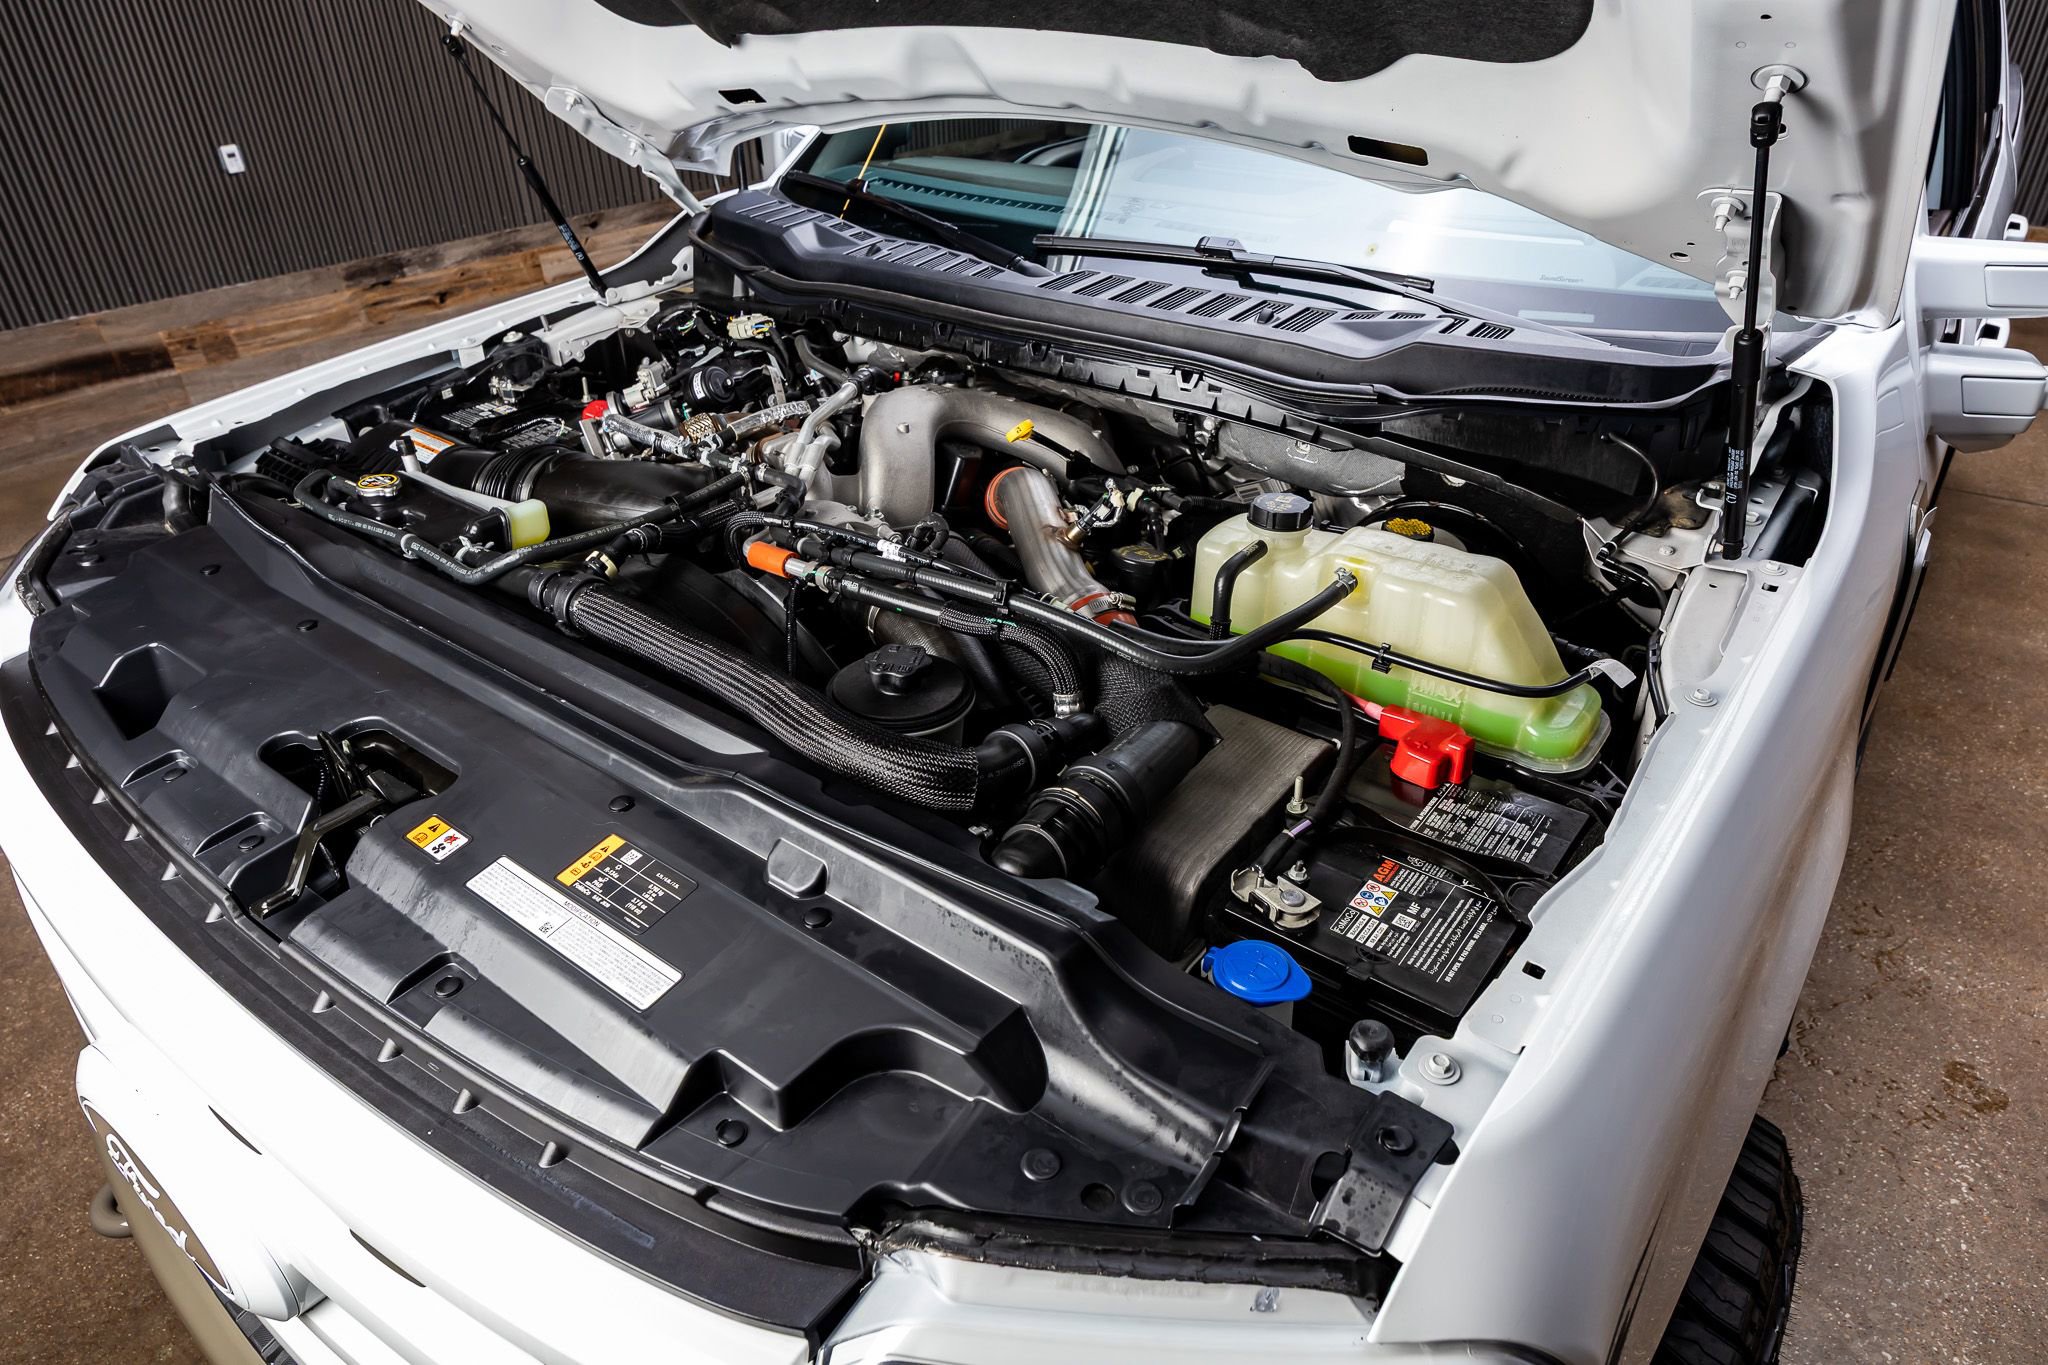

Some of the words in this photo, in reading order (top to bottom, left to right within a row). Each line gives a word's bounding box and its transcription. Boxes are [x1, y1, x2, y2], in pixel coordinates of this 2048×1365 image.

[1373, 860, 1395, 882] AGM
[563, 901, 602, 927] MODIFICATION
[1407, 902, 1420, 915] MF
[1333, 910, 1356, 933] FoMoCo
[106, 1133, 195, 1262] Ford
